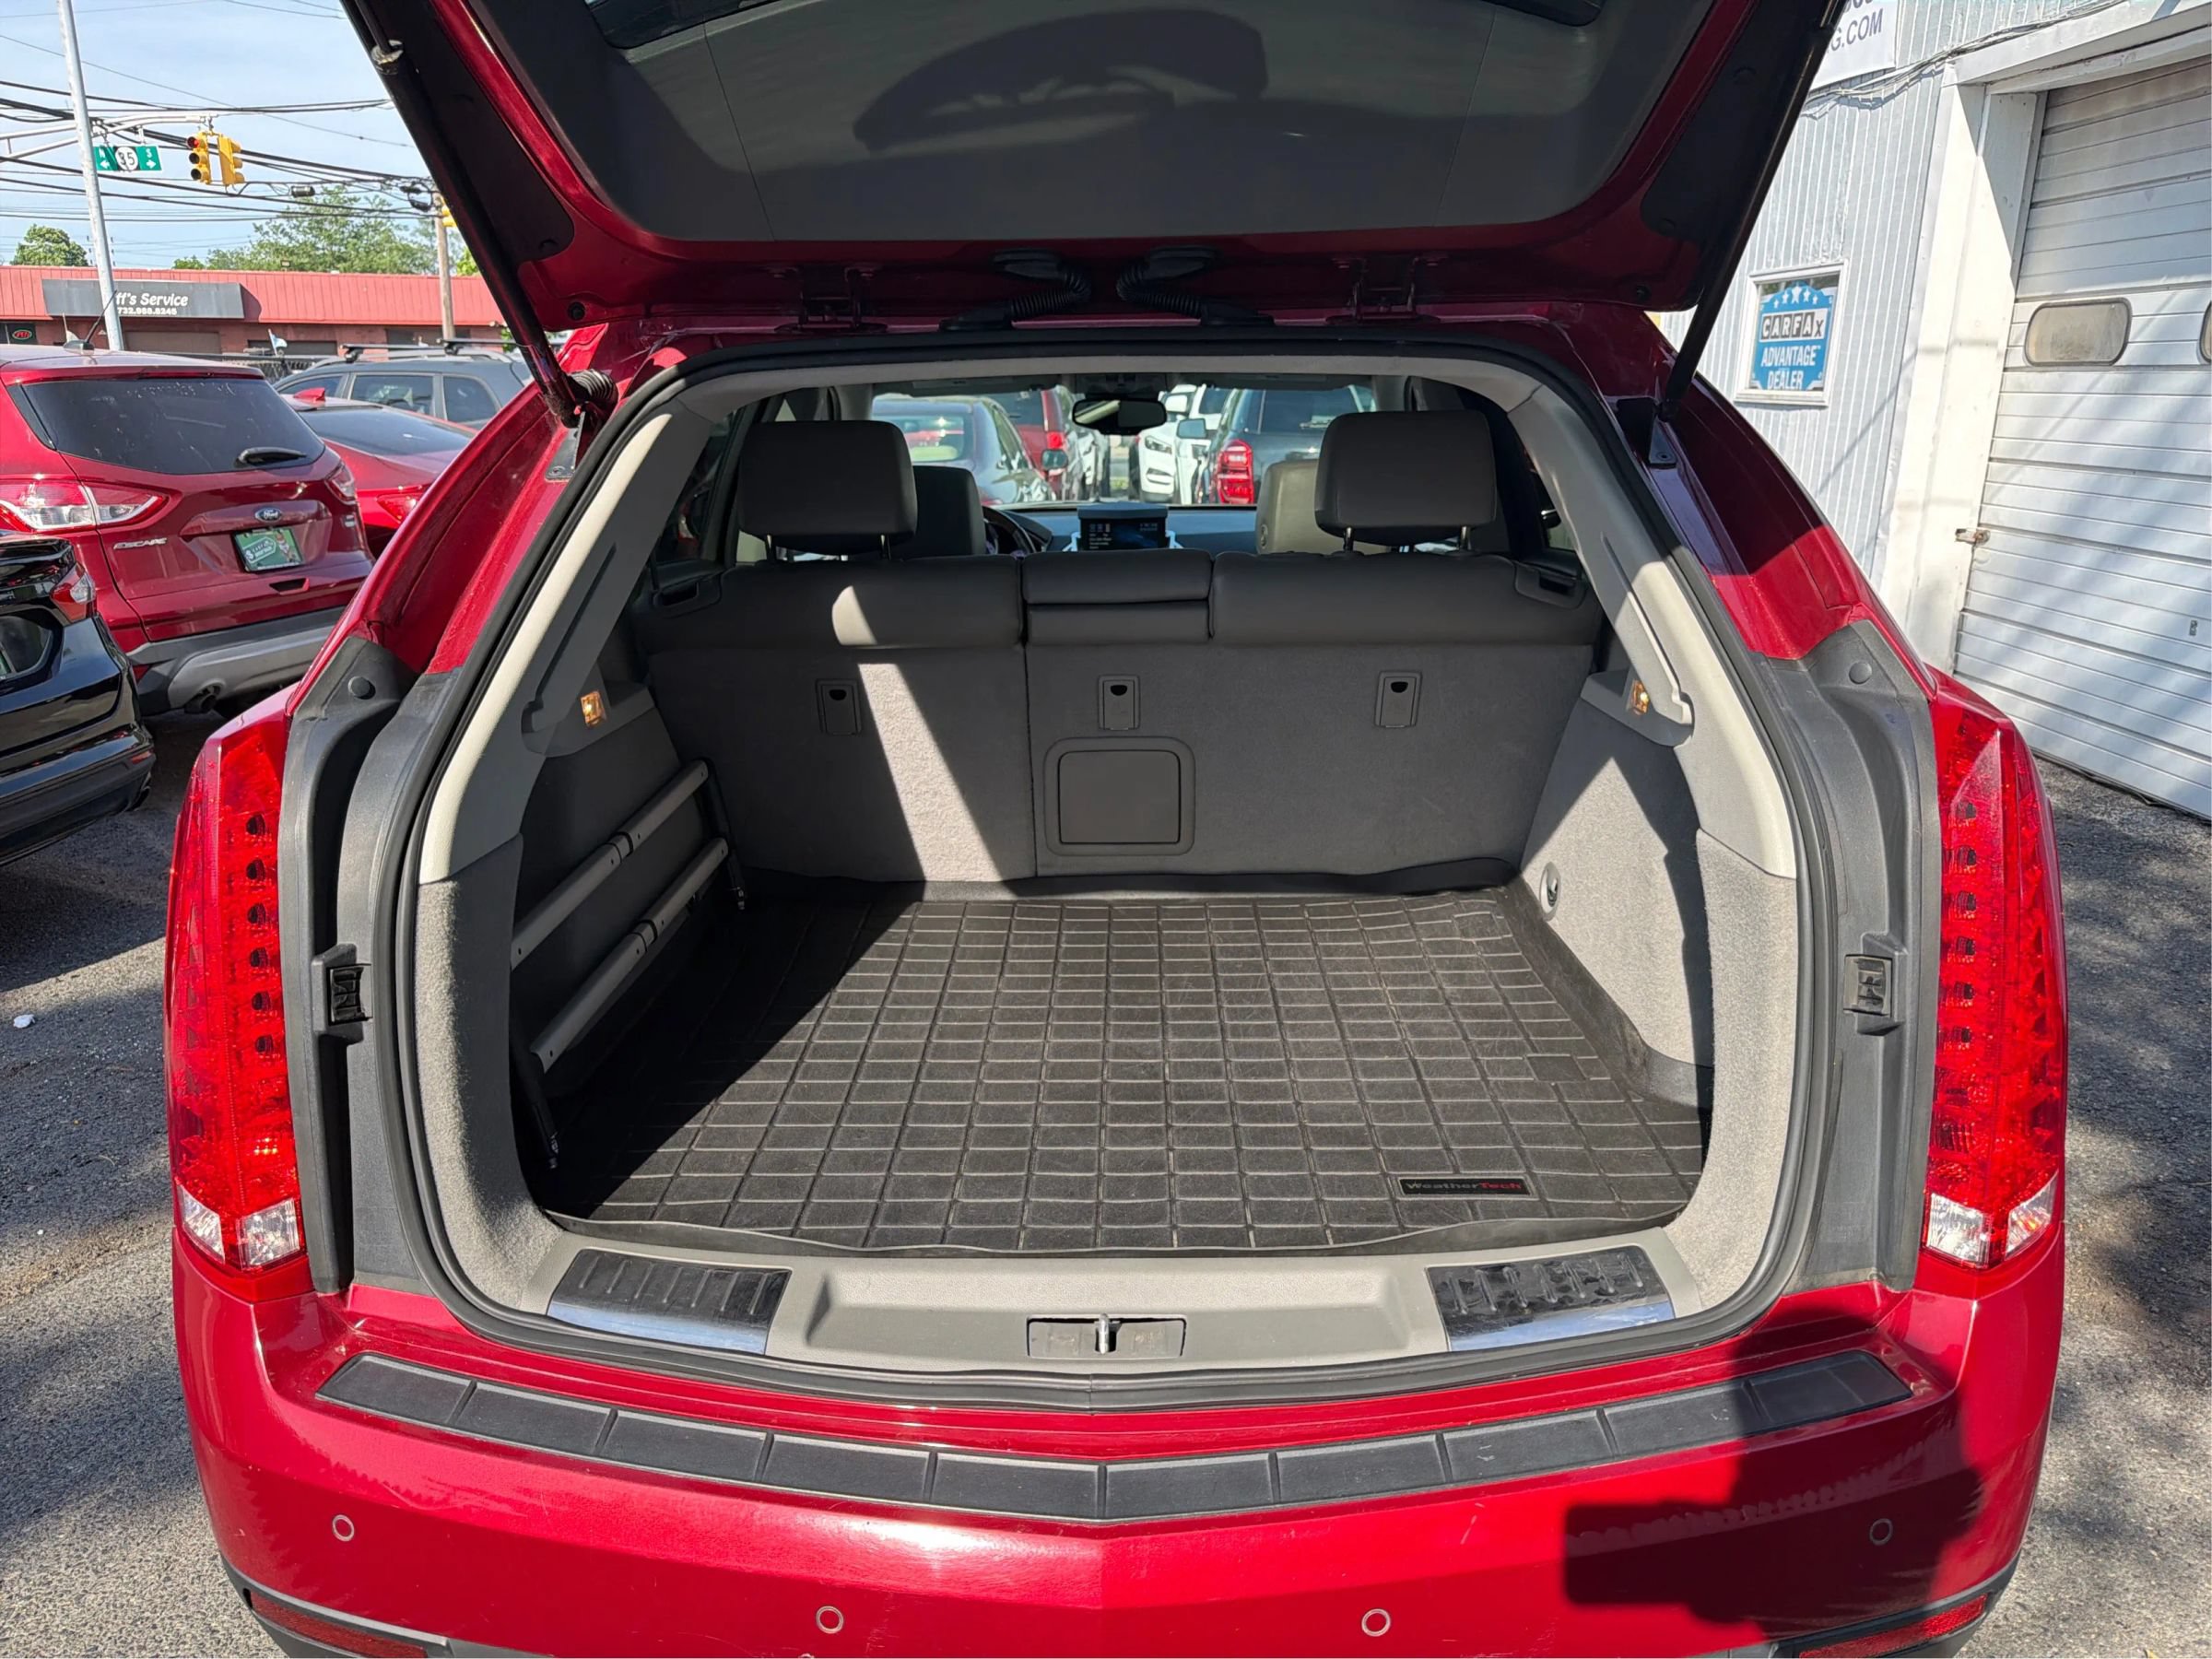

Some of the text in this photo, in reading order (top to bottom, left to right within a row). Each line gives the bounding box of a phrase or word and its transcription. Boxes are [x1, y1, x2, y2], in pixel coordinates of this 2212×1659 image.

[1830, 7, 1883, 51] G.COM
[118, 152, 135, 166] 35
[146, 148, 153, 158] S
[116, 292, 188, 306] ff's Service
[1761, 312, 1824, 339] CARFAX
[1760, 346, 1818, 367] ADVANTAGE
[1767, 370, 1804, 390] DEALER
[1405, 1181, 1522, 1190] WeatherTech
